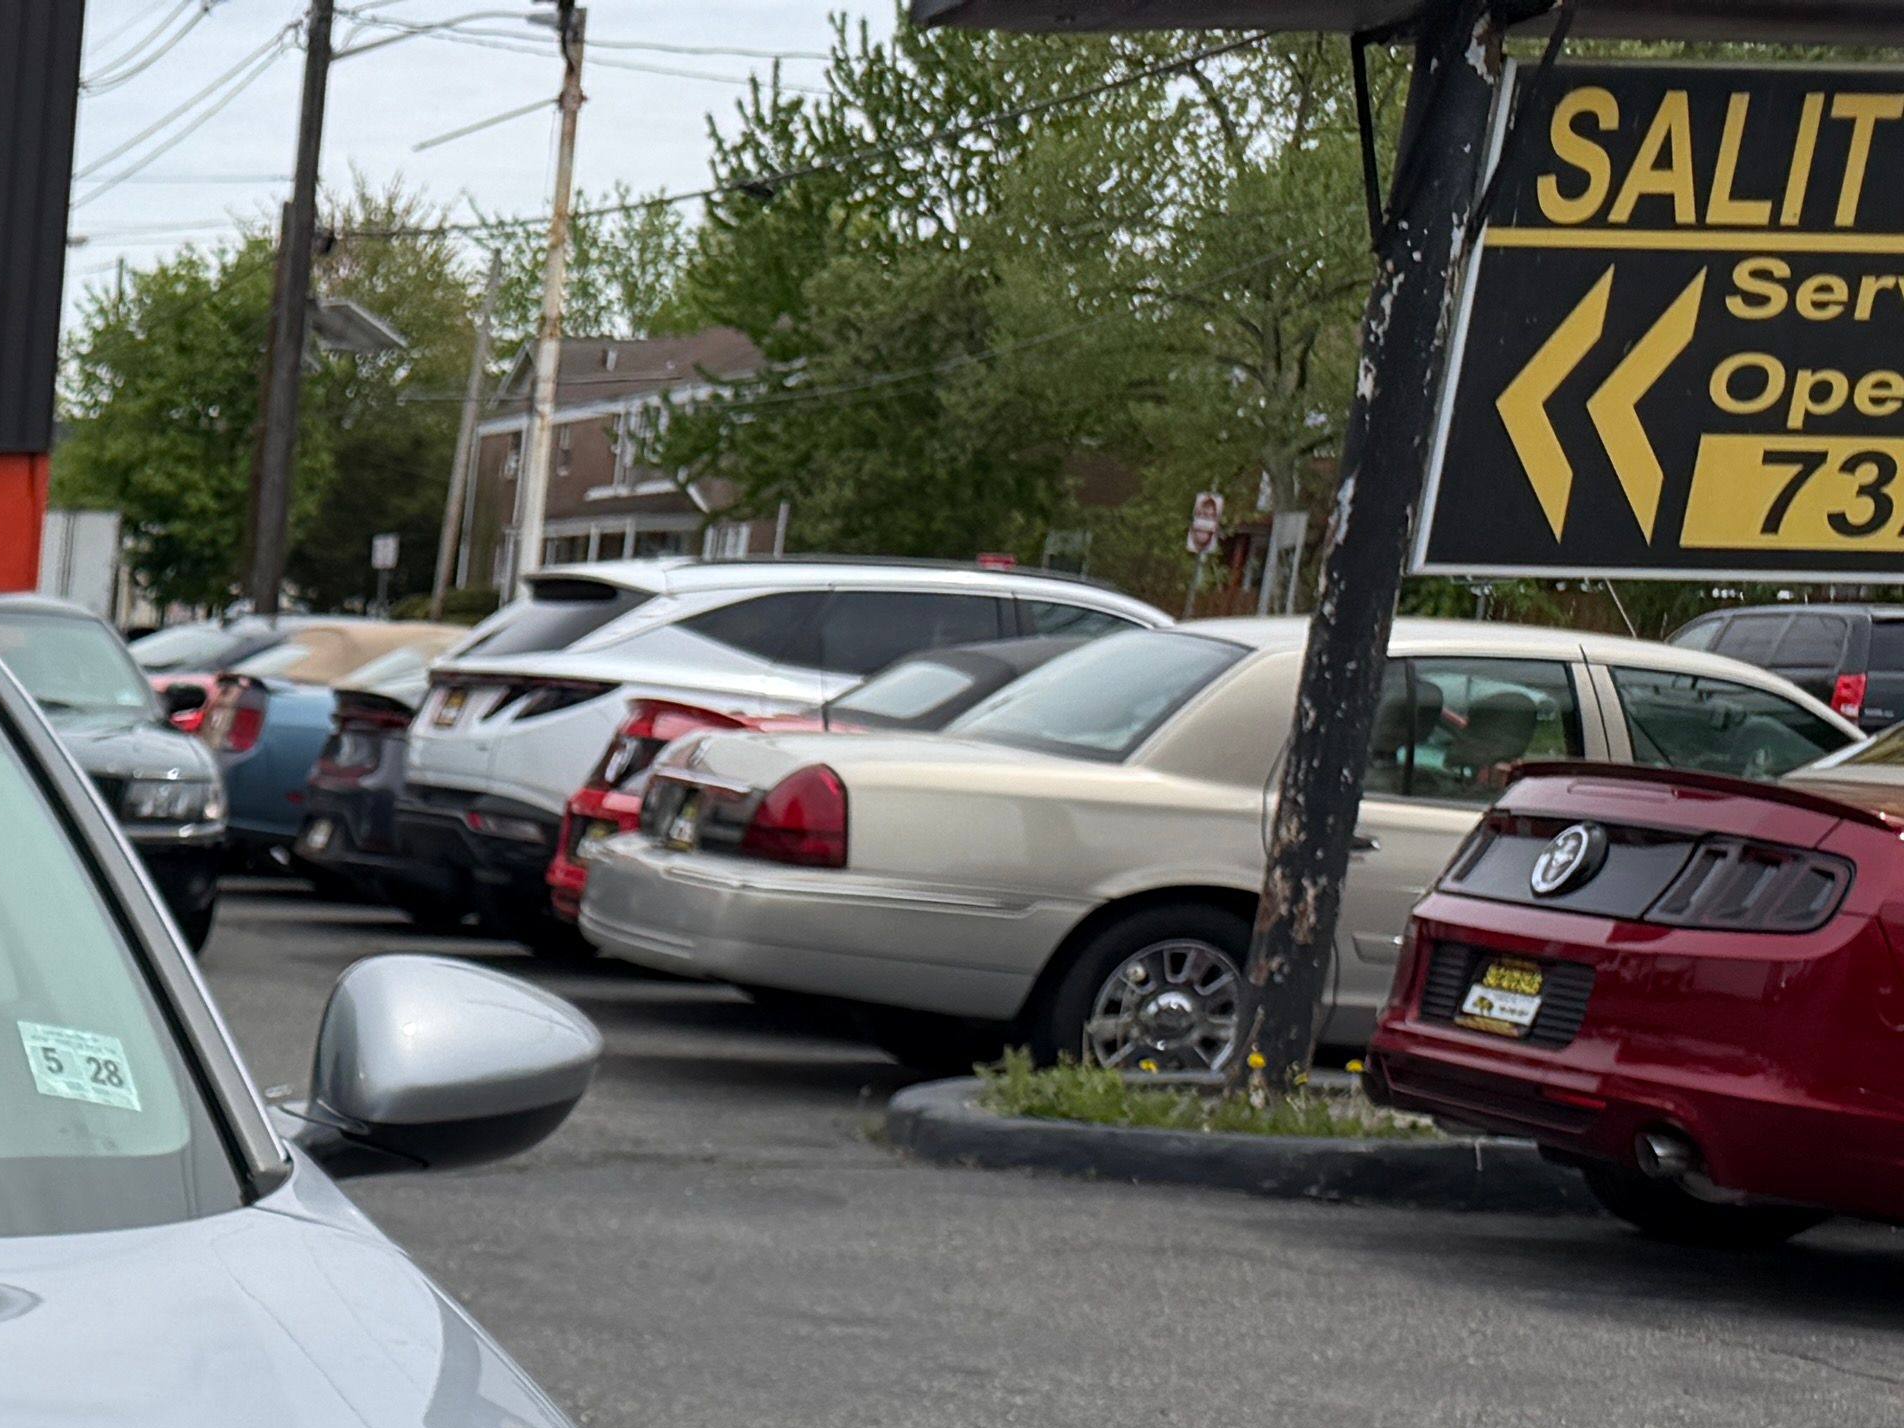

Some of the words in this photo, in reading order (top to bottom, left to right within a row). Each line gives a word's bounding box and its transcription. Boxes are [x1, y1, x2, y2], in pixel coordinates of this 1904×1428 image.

[1537, 86, 1904, 226] SALIT
[1725, 256, 1904, 321] Ser
[1760, 450, 1904, 538] 73
[41, 1046, 64, 1075] 5
[86, 1056, 124, 1088] 28
